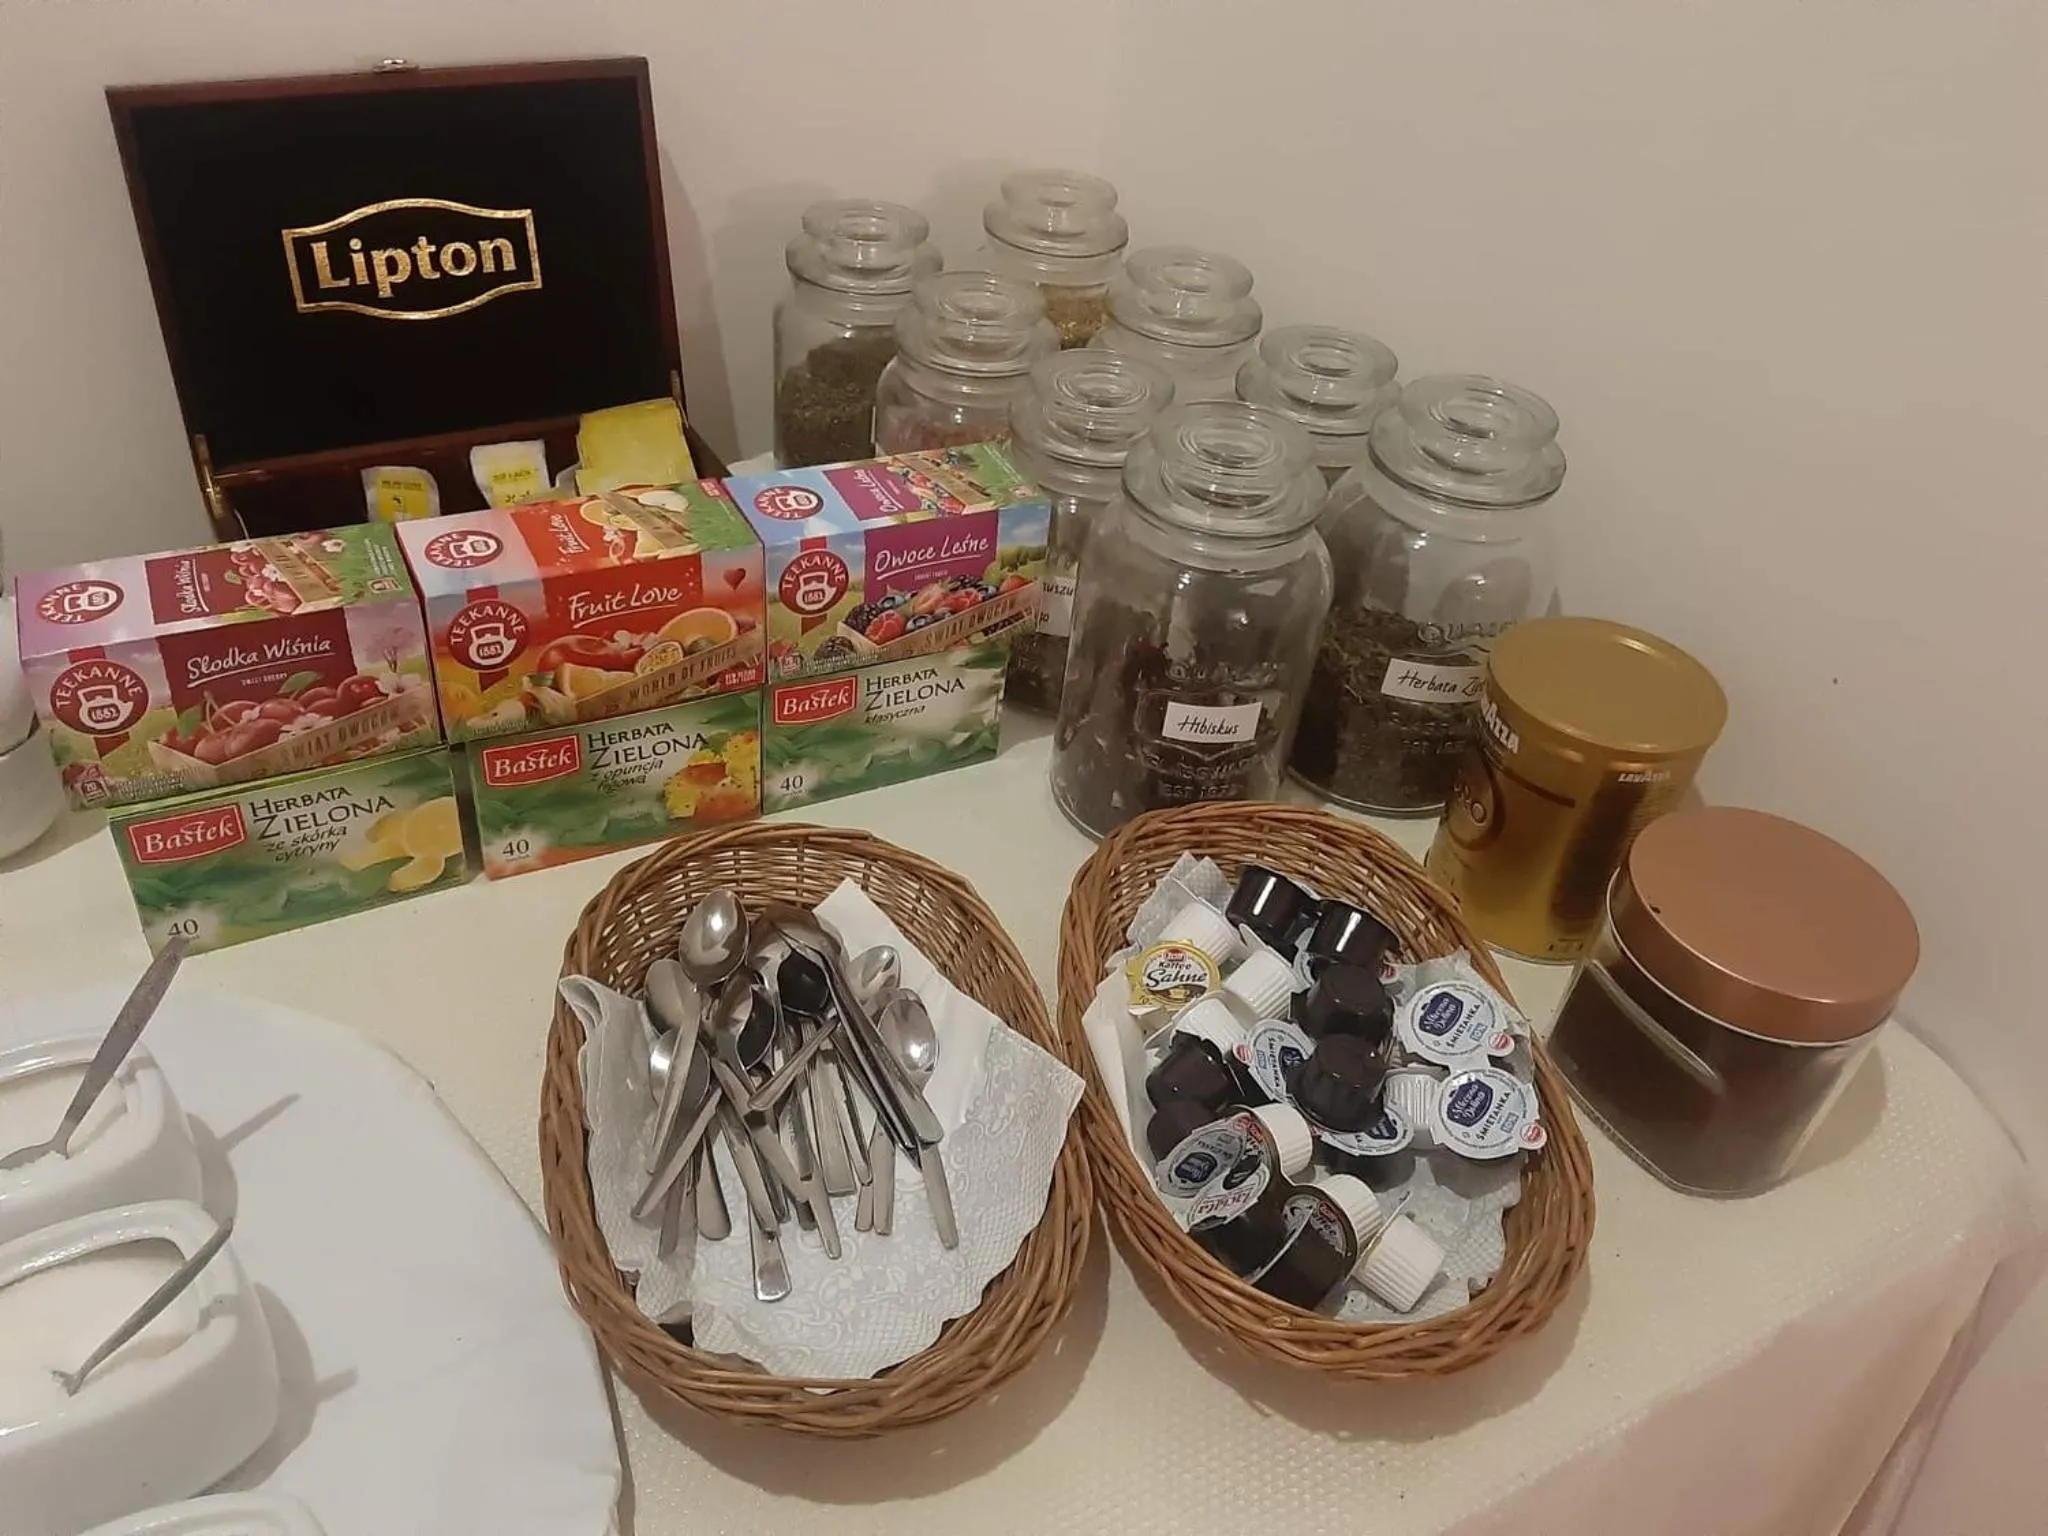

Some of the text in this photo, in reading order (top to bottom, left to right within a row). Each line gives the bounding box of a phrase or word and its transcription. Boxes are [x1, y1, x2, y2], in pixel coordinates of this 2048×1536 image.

[309, 235, 517, 298] Lipton
[874, 533, 990, 573] Owoce Leśne
[782, 555, 847, 589] TEEKANNE
[568, 583, 682, 621] Fruit Love
[450, 604, 527, 646] TEEKANNE
[186, 634, 333, 680] Słodka Wiśnia
[55, 666, 144, 710] TEEKANNE
[1397, 670, 1458, 694] Herbata
[1176, 714, 1240, 736] Hibiskus
[780, 775, 804, 791] 40
[502, 839, 530, 857] 40
[166, 918, 199, 937] 40
[1145, 968, 1208, 988] Sahne
